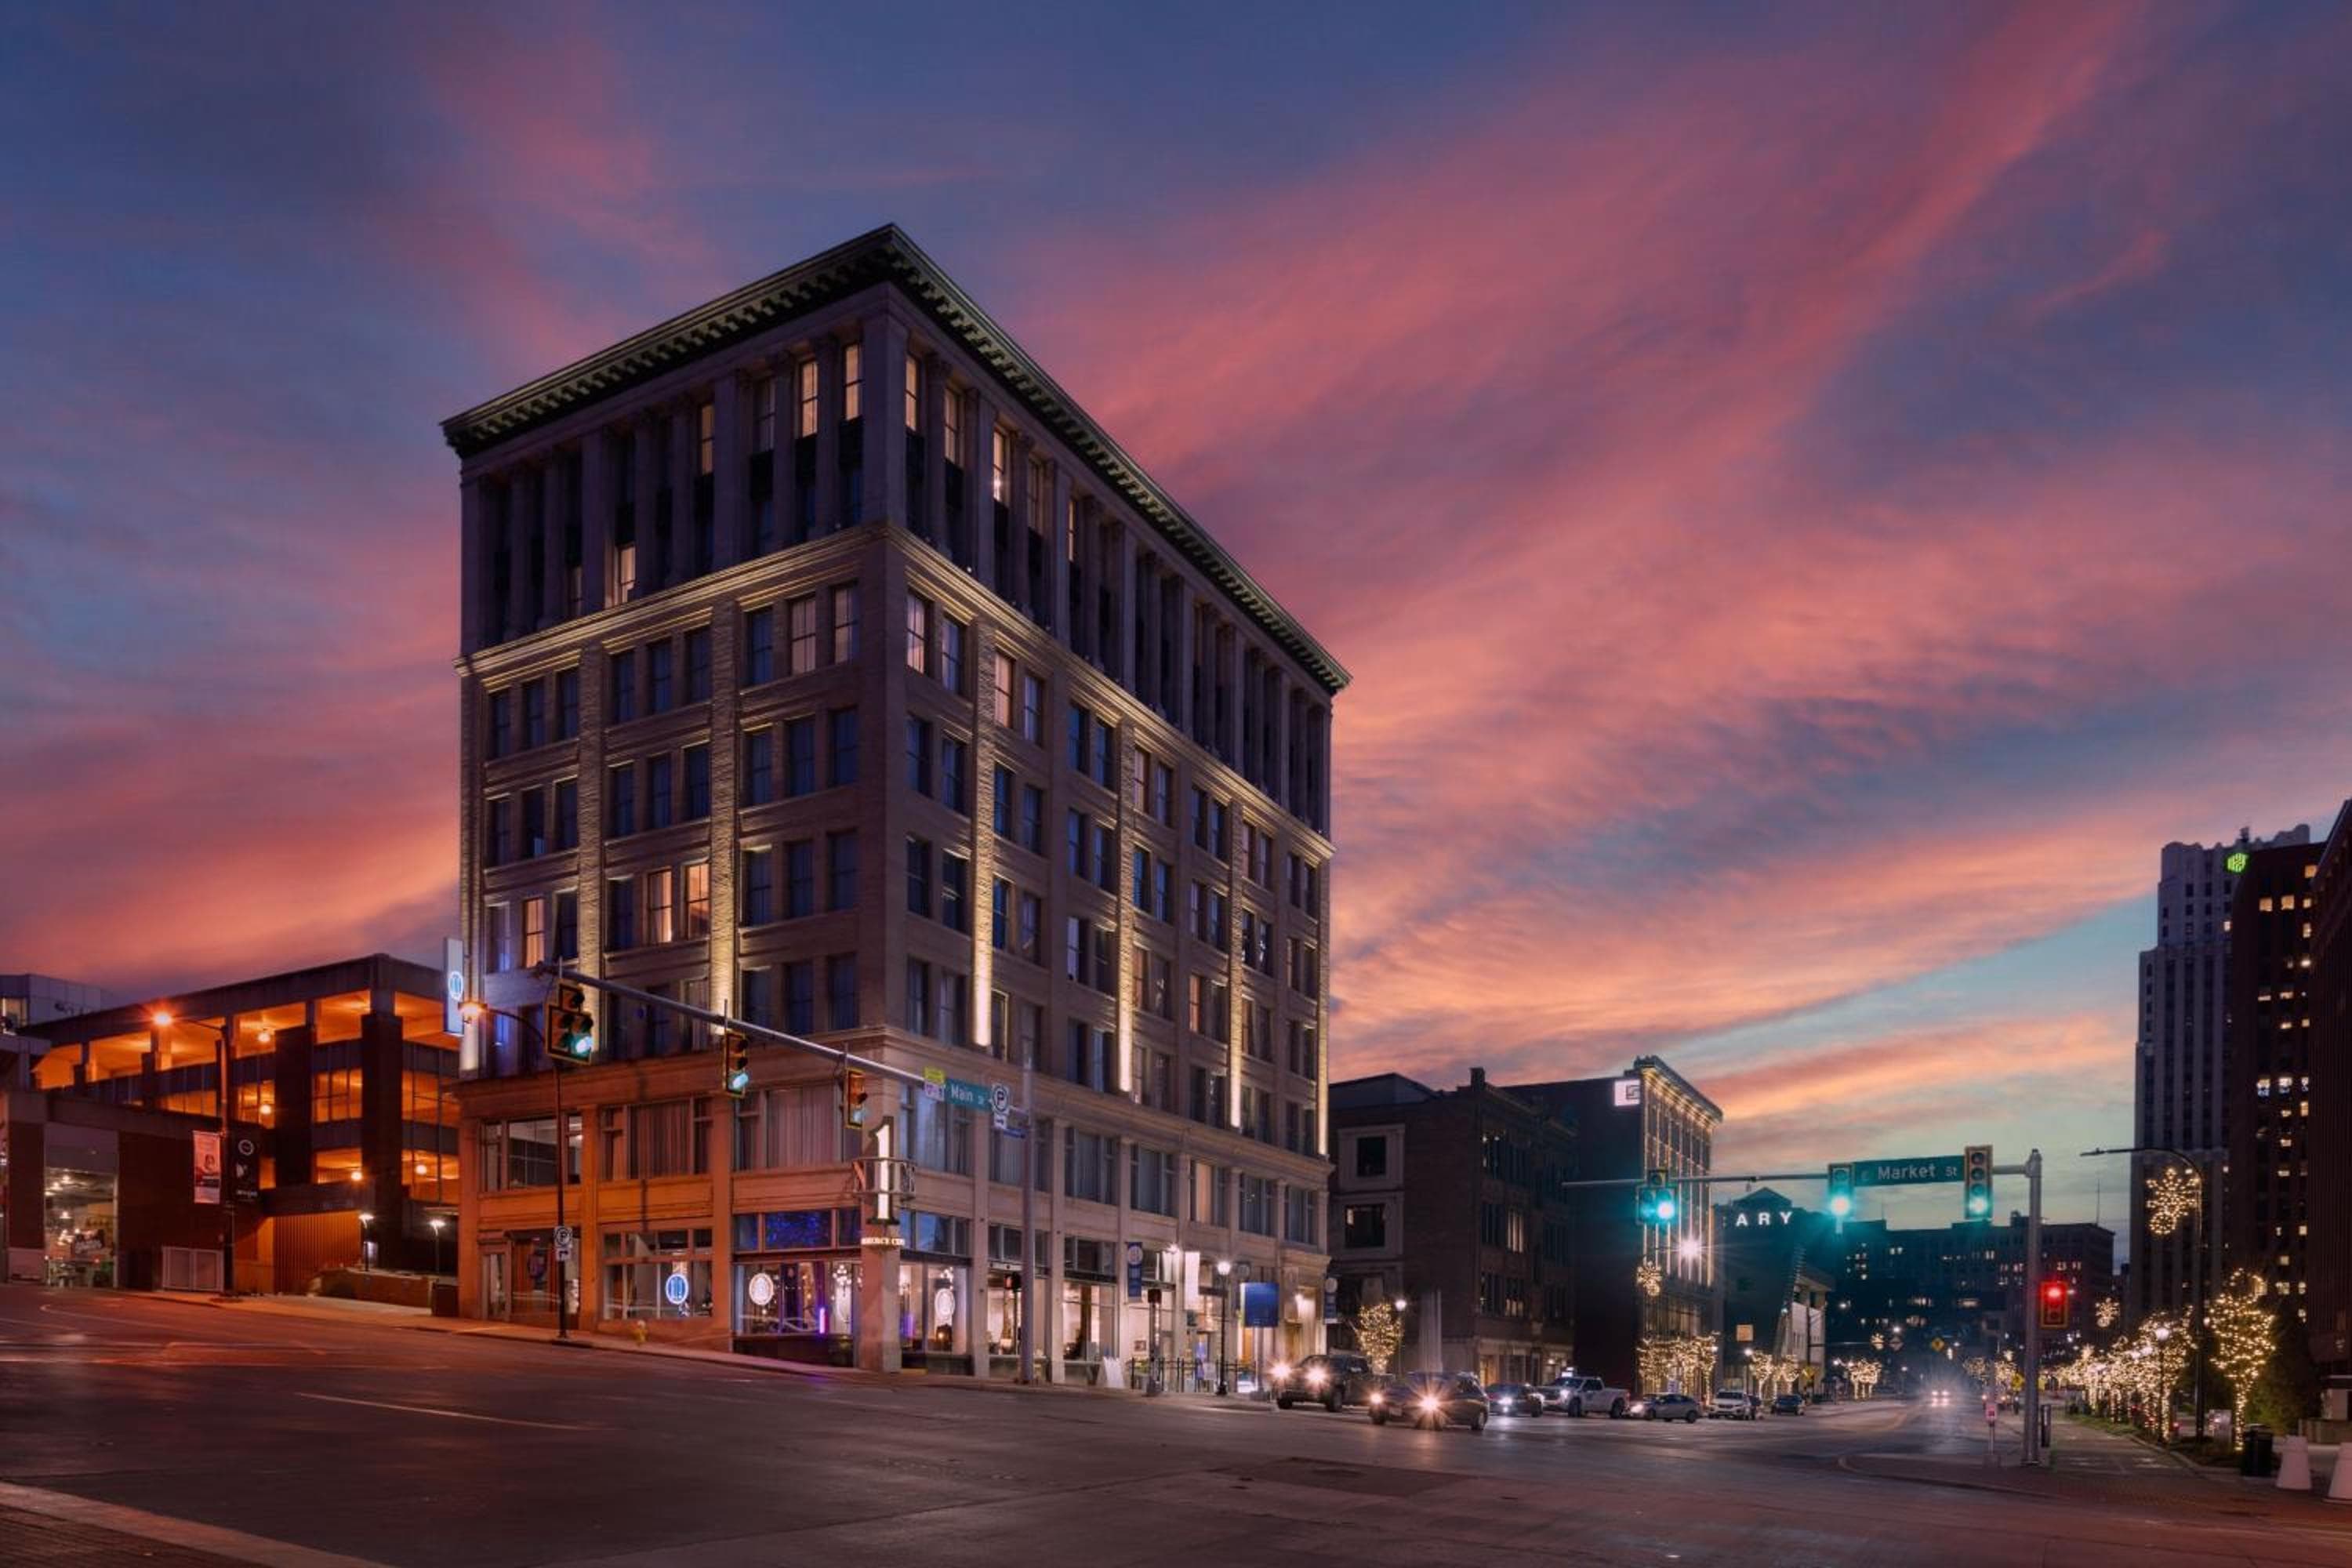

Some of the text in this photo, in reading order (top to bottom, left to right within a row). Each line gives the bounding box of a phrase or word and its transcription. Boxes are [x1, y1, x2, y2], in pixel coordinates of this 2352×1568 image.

[951, 1084, 973, 1102] Main
[1878, 1163, 1936, 1180] Market
[1945, 1166, 1958, 1177] St
[1722, 1211, 1793, 1227] ARY
